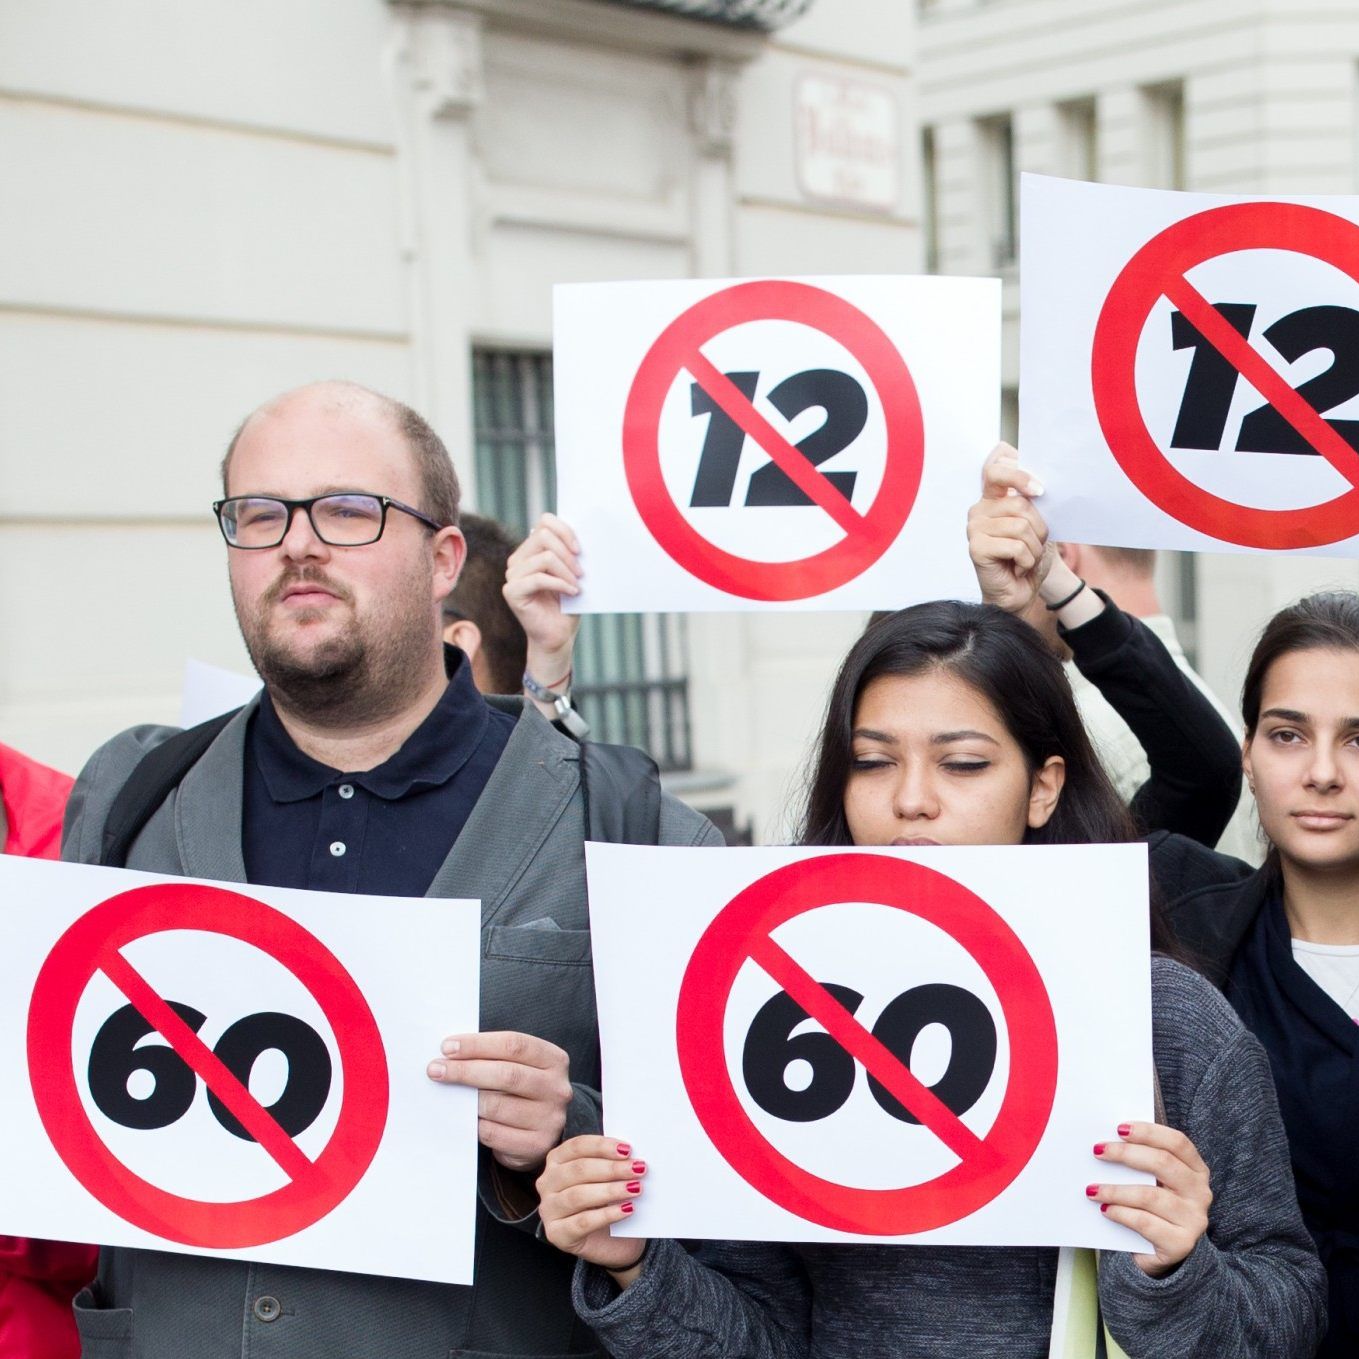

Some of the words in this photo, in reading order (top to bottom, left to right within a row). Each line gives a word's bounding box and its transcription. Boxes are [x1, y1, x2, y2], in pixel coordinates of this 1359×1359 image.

[690, 368, 869, 507] 12
[88, 1000, 332, 1143] 60
[742, 982, 998, 1126] 60
